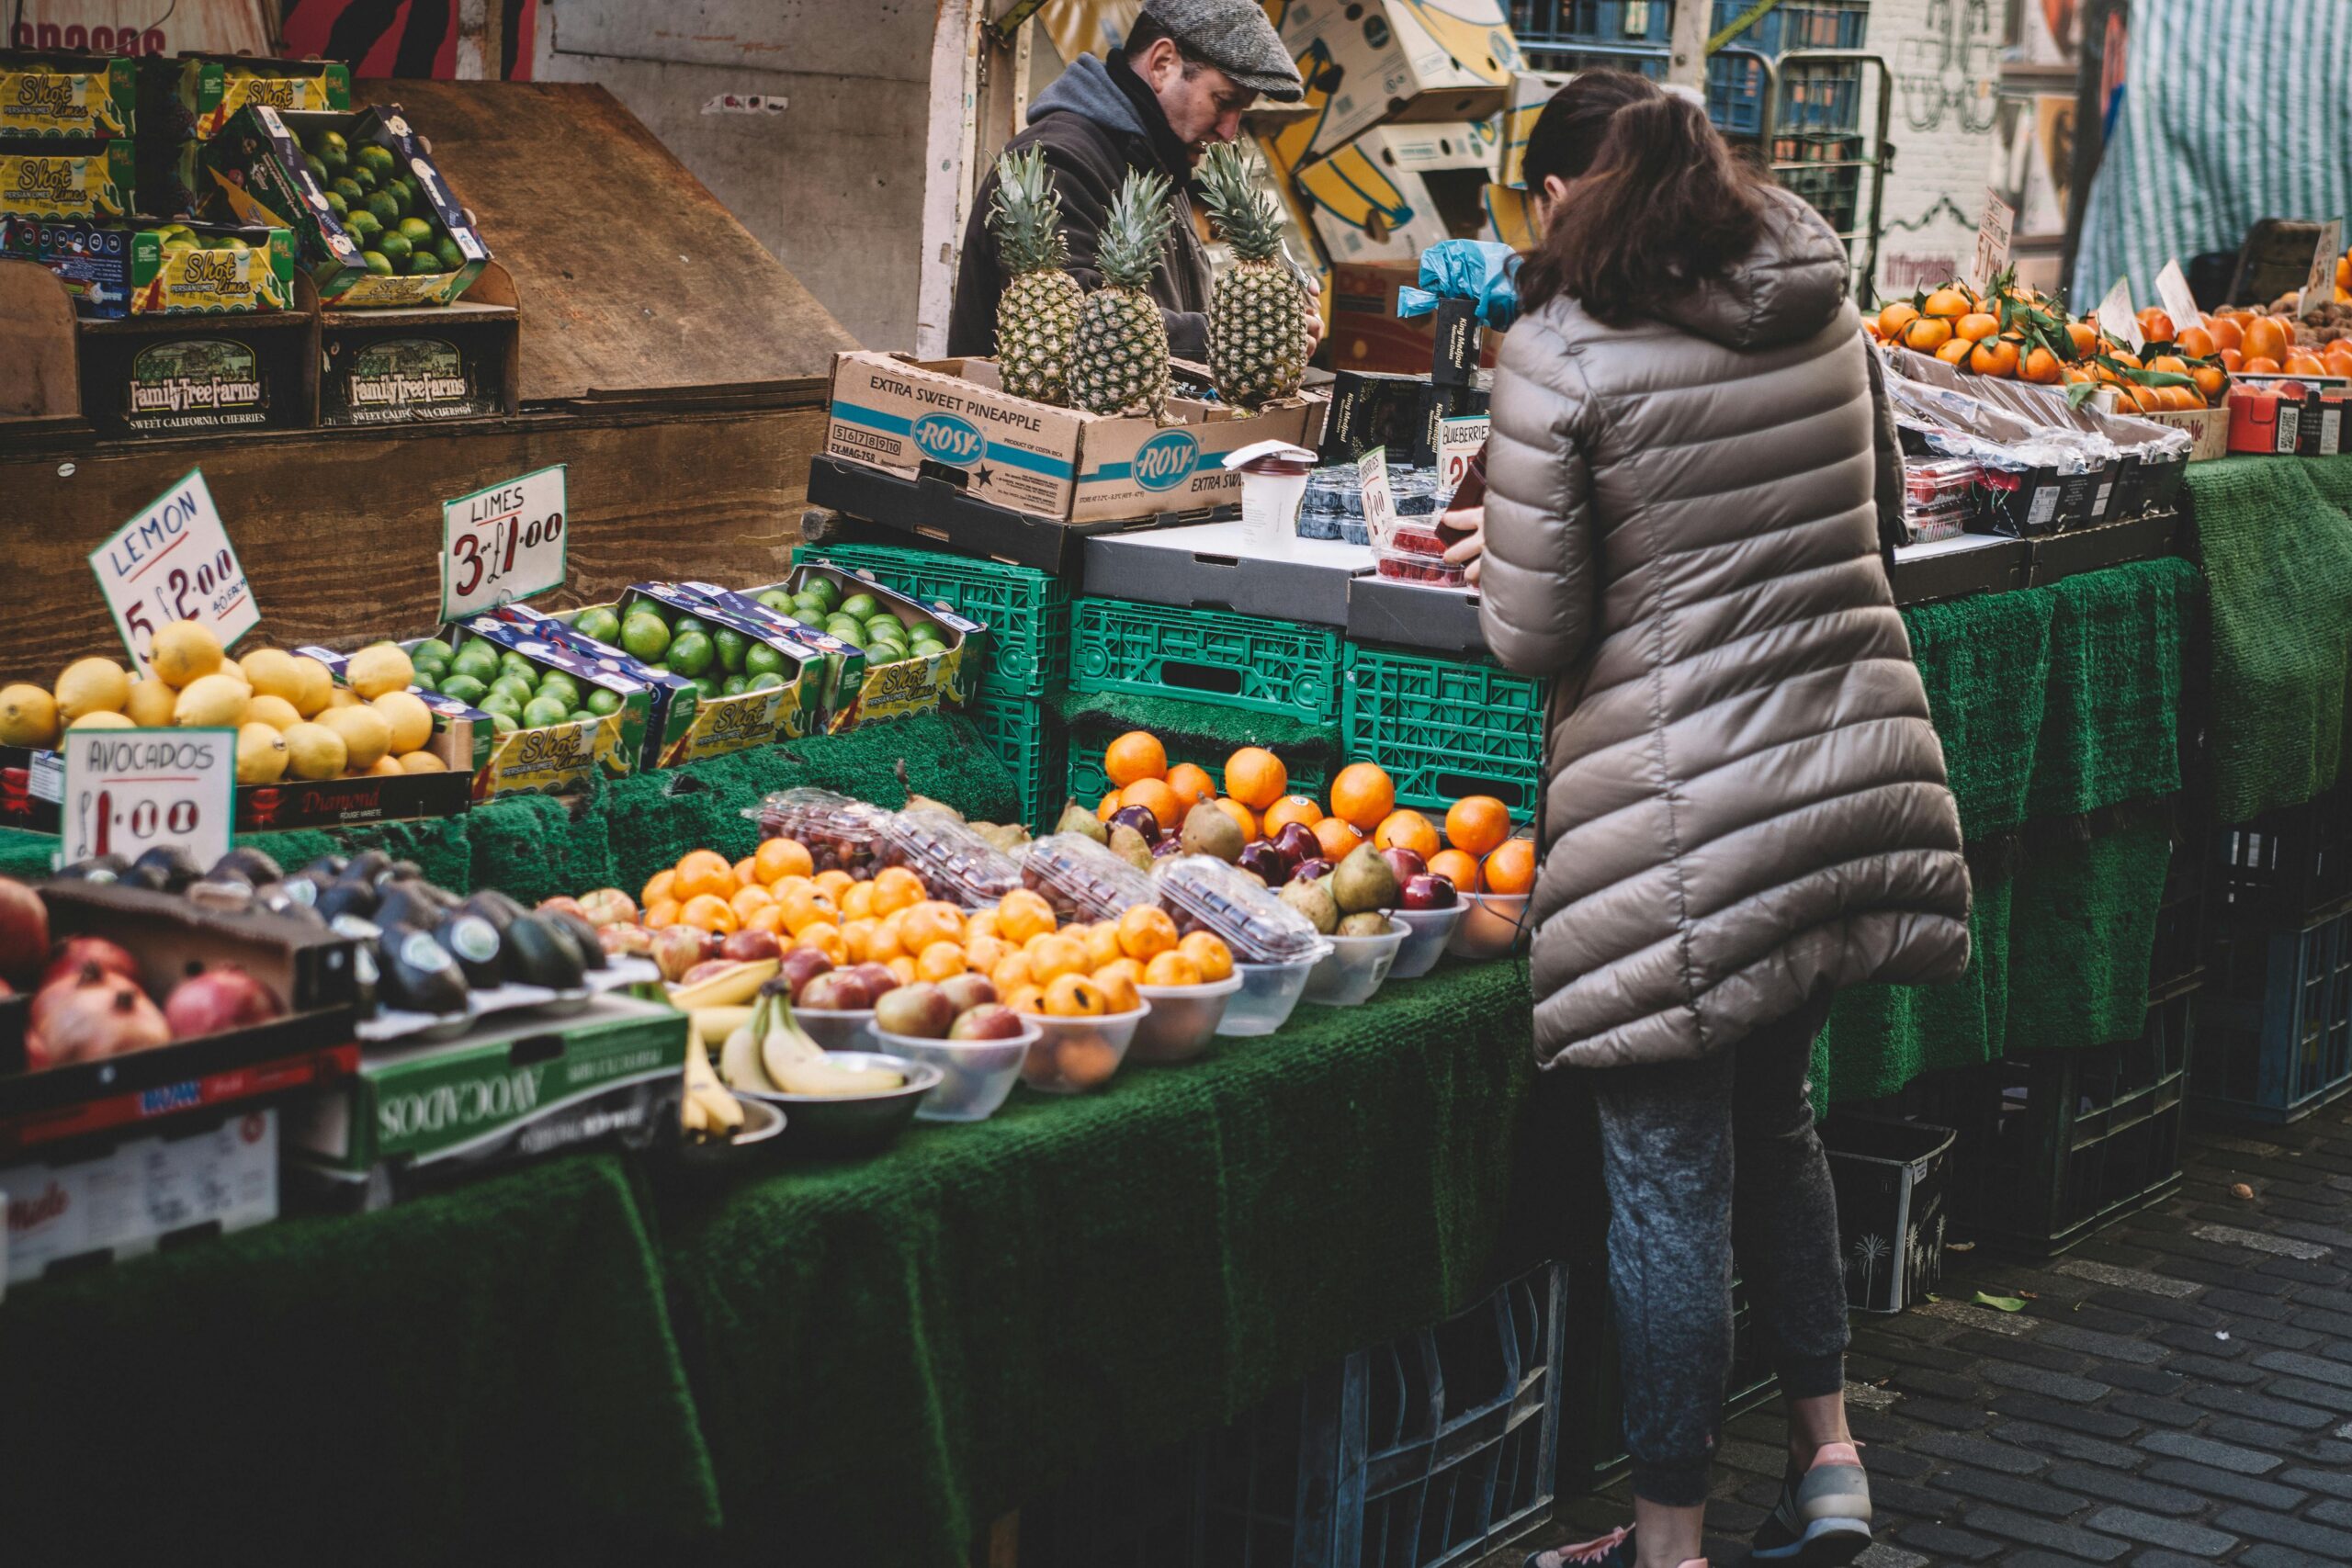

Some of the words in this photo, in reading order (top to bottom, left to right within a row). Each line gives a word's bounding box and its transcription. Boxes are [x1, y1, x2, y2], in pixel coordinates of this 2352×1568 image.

[18, 73, 74, 105] Shot
[18, 158, 73, 190] Shot
[185, 251, 236, 283] Shot
[1456, 317, 1467, 336] King
[1454, 335, 1465, 368] Medjoul
[869, 375, 913, 399] EXTRA
[915, 388, 965, 412] SWEET
[966, 400, 1042, 433] PINEAPPLE
[1344, 392, 1354, 408] King
[1433, 402, 1443, 421] King
[130, 417, 162, 431] SWEET
[163, 415, 220, 428] CALIFORNIA
[220, 412, 266, 424] CHERRIES
[1340, 410, 1352, 443] Medjoul
[836, 428, 844, 438] 5
[859, 434, 865, 444] 7
[868, 435, 876, 446] 8
[878, 439, 886, 448] 9
[888, 442, 899, 453] 10
[920, 422, 978, 456] ROSY
[1003, 437, 1028, 448] PRODUCT
[1035, 446, 1051, 456] COSTA
[1051, 449, 1063, 458] RICA
[1138, 445, 1193, 479] ROSY
[1191, 477, 1221, 492] EXTRA
[470, 487, 525, 524] LIMES
[110, 491, 198, 578] LEMON
[454, 533, 484, 596] 3
[487, 513, 563, 584] £1.00
[228, 577, 247, 600] EACH
[125, 599, 156, 664] 5
[880, 657, 930, 695] Shot
[713, 695, 768, 734] Shot
[87, 740, 215, 773] AVOCADOS
[519, 724, 583, 763] Shot
[301, 779, 386, 814] Diamond
[76, 789, 200, 858] £1.00
[339, 810, 360, 819] ROUGE
[377, 1064, 546, 1143] AVOCADOS
